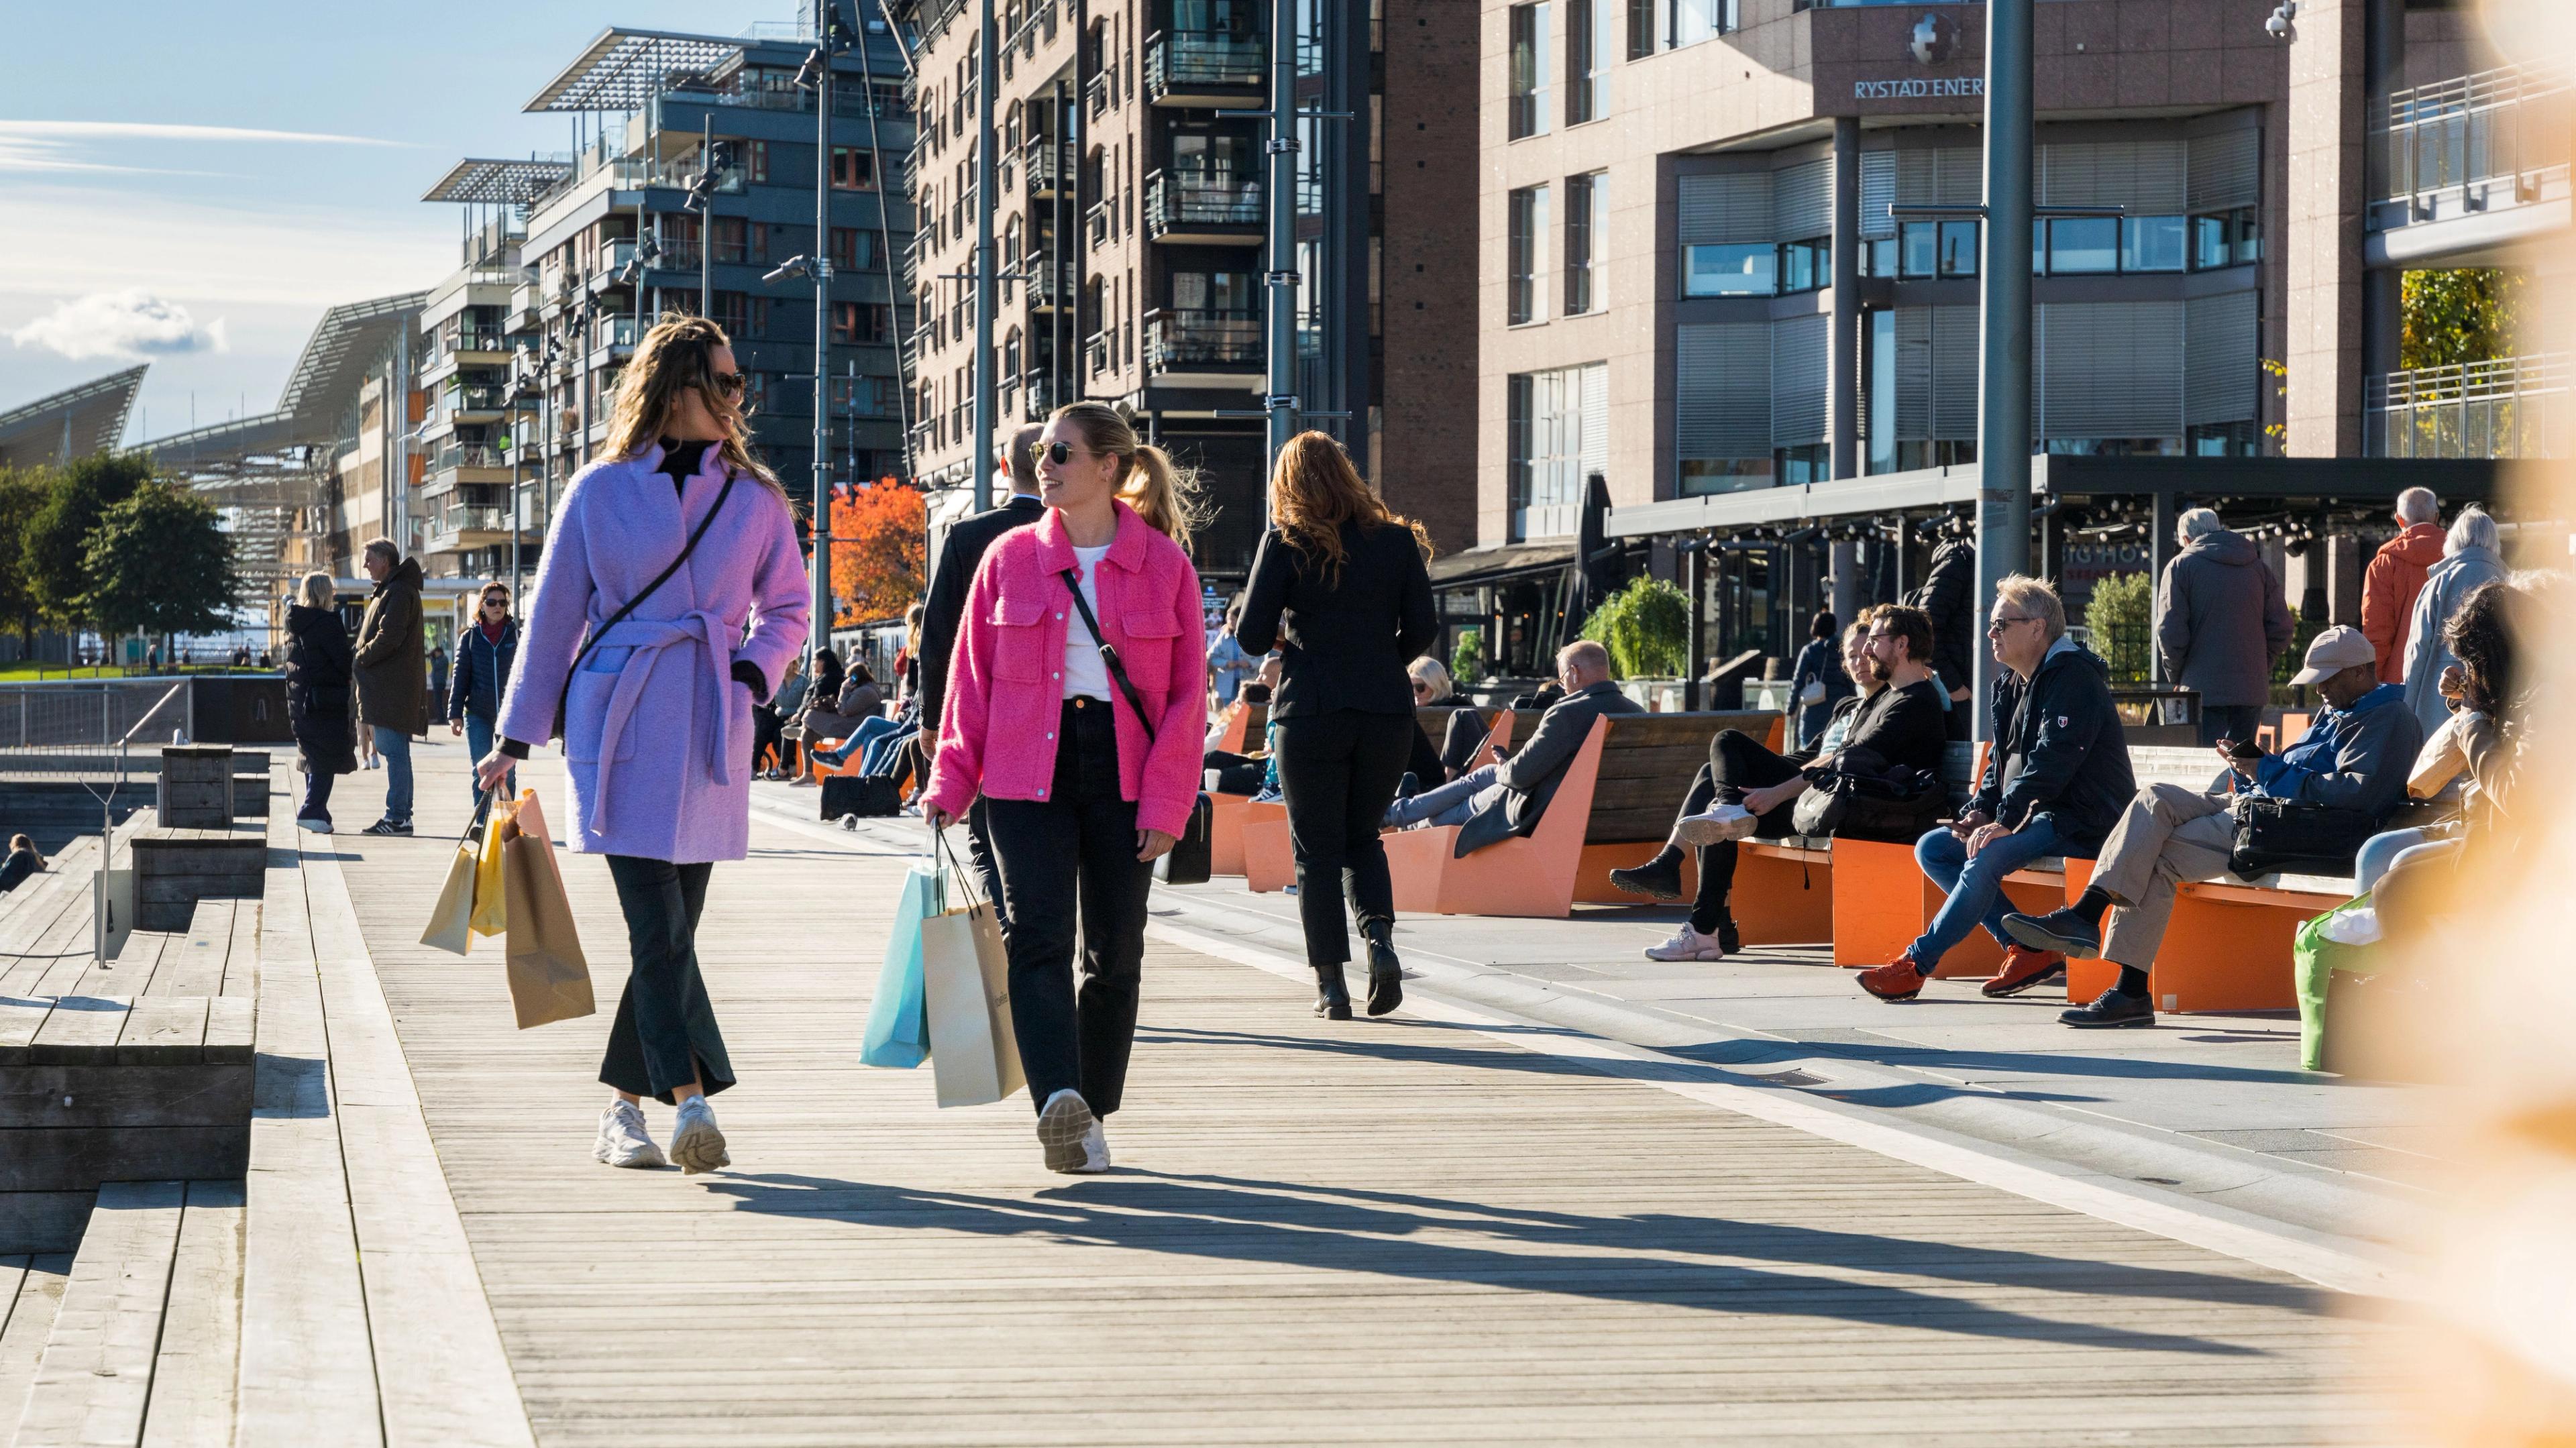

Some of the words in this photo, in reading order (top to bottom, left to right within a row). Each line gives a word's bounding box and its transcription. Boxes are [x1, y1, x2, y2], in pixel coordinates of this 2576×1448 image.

[1855, 79, 1927, 99] RYSTAD
[1933, 78, 1984, 96] ENER
[2062, 545, 2092, 564] IG
